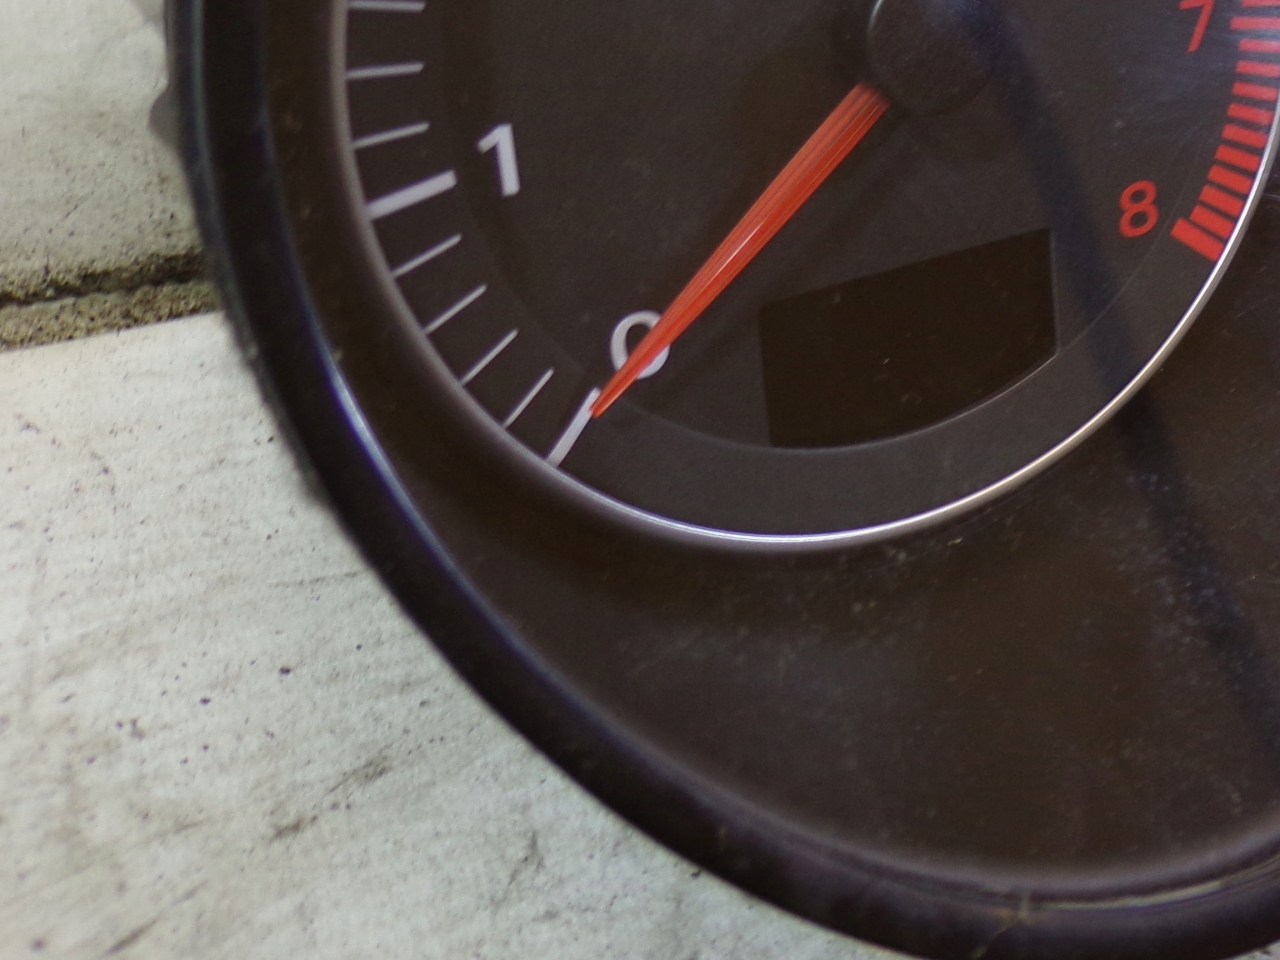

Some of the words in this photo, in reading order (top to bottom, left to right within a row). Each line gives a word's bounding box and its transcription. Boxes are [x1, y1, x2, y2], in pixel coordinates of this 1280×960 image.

[478, 124, 520, 197] 1
[1119, 180, 1160, 238] 8
[611, 310, 671, 379] 0
